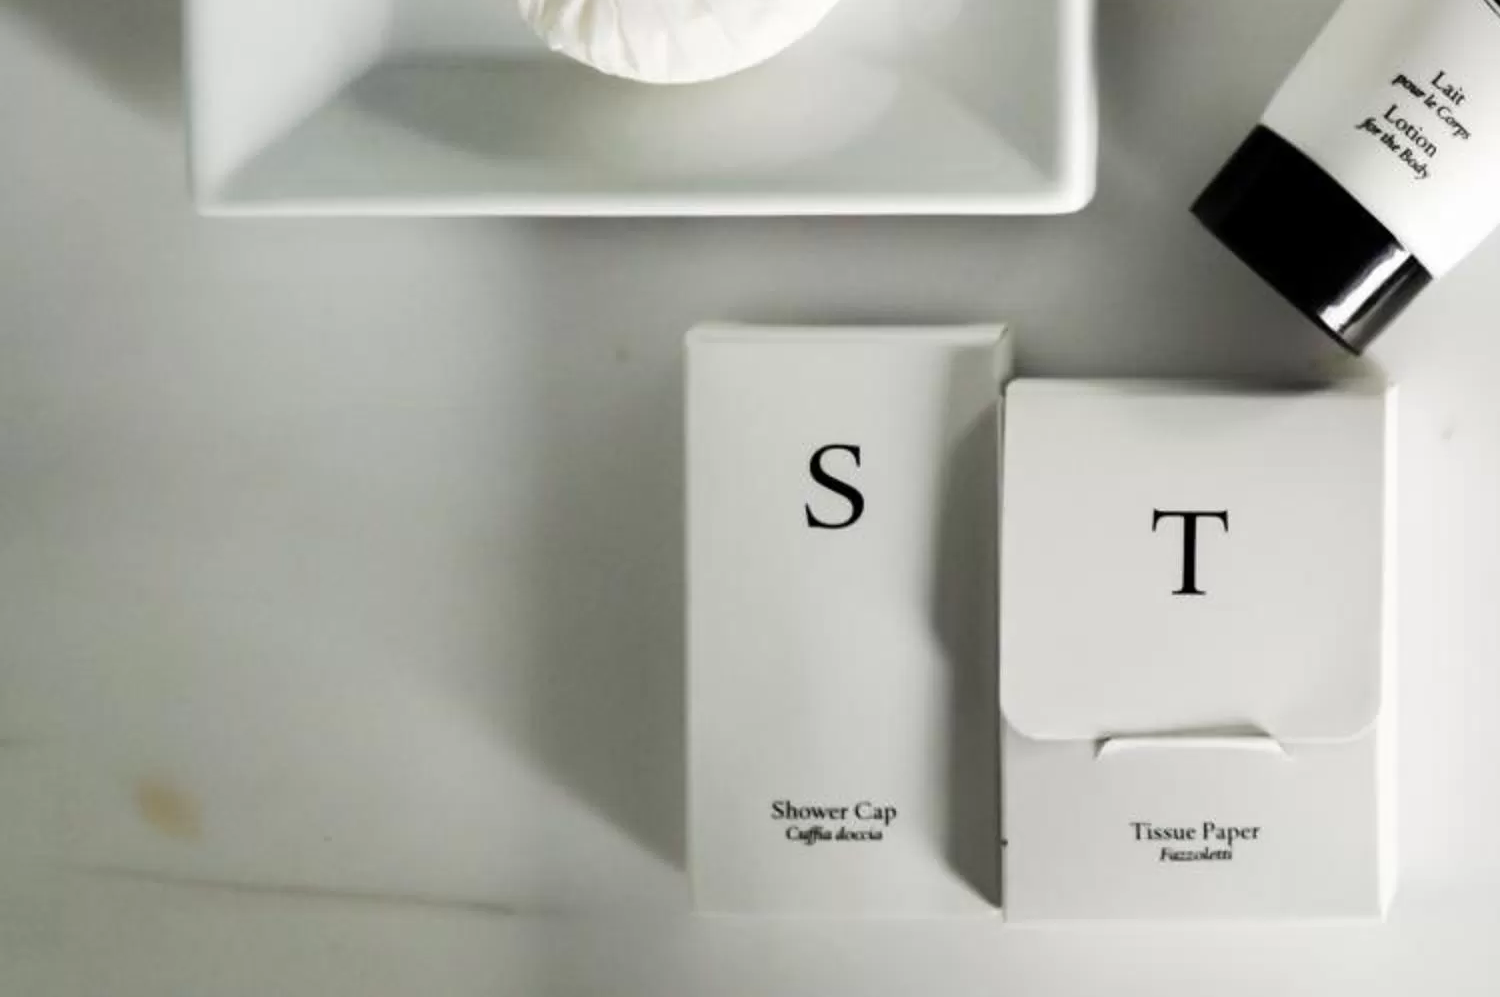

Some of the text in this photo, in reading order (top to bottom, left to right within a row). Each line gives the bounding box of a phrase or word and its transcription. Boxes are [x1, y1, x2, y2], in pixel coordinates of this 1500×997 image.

[1391, 74, 1426, 98] pour
[1437, 105, 1471, 140] Corps
[1431, 70, 1465, 106] Lait
[1354, 117, 1428, 180] for the Body
[1384, 103, 1437, 158] Lotion
[804, 443, 865, 530] S
[1151, 507, 1229, 596] T
[770, 800, 897, 827] Shower Cap
[785, 826, 883, 846] Cuffia doccia
[1129, 821, 1262, 847] Tissue Paper
[1159, 846, 1233, 862] Fazzoletti
